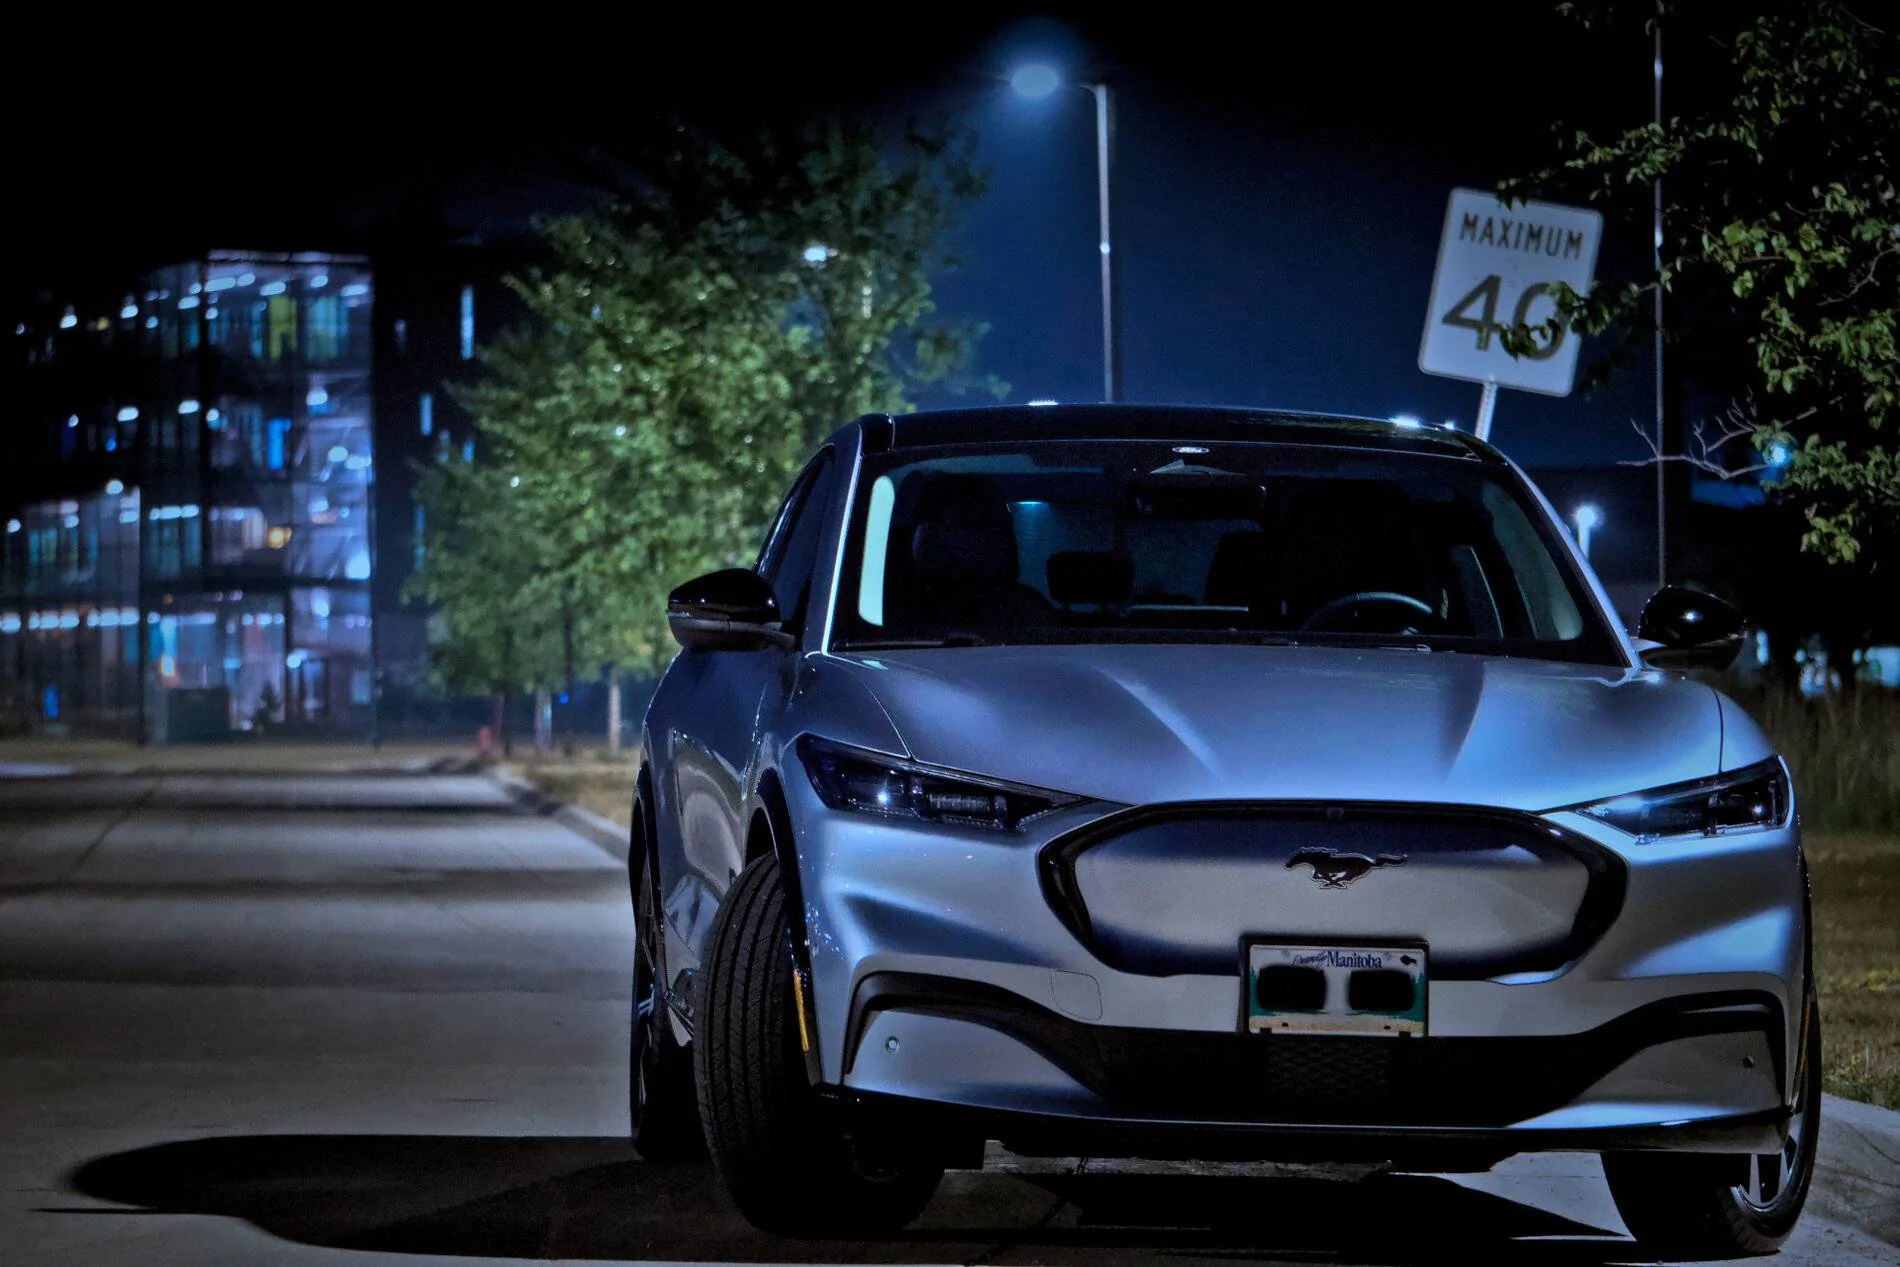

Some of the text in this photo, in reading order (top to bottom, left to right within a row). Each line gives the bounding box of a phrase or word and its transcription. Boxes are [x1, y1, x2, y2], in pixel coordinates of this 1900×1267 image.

[1459, 211, 1583, 261] MAXIMUM
[1441, 274, 1569, 360] 40
[1327, 950, 1383, 968] Manitoba
